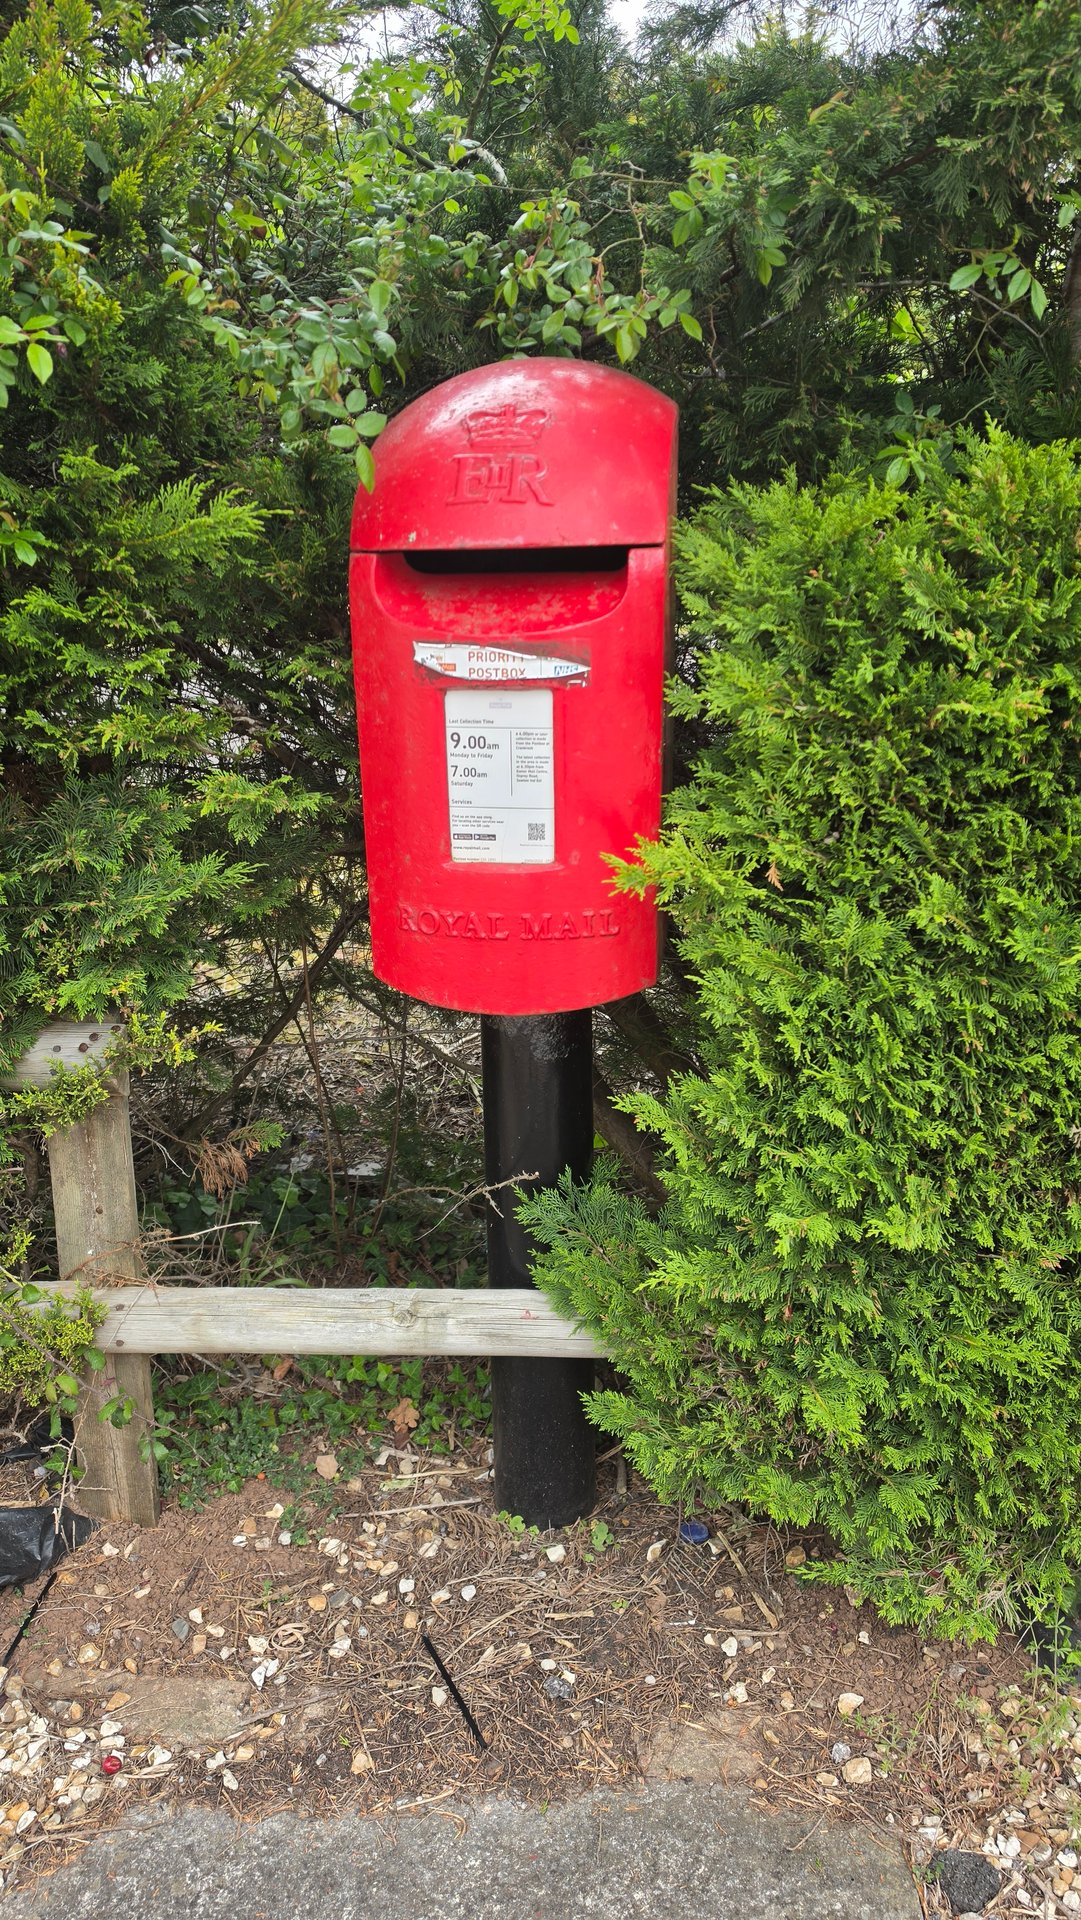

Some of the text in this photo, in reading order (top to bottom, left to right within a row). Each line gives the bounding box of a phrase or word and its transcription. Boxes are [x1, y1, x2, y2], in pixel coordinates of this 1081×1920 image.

[468, 667, 526, 678] POSTBOX
[450, 732, 500, 750] 9.00am
[450, 765, 488, 778] 7.00am
[400, 904, 621, 940] ROYAL MAIL
